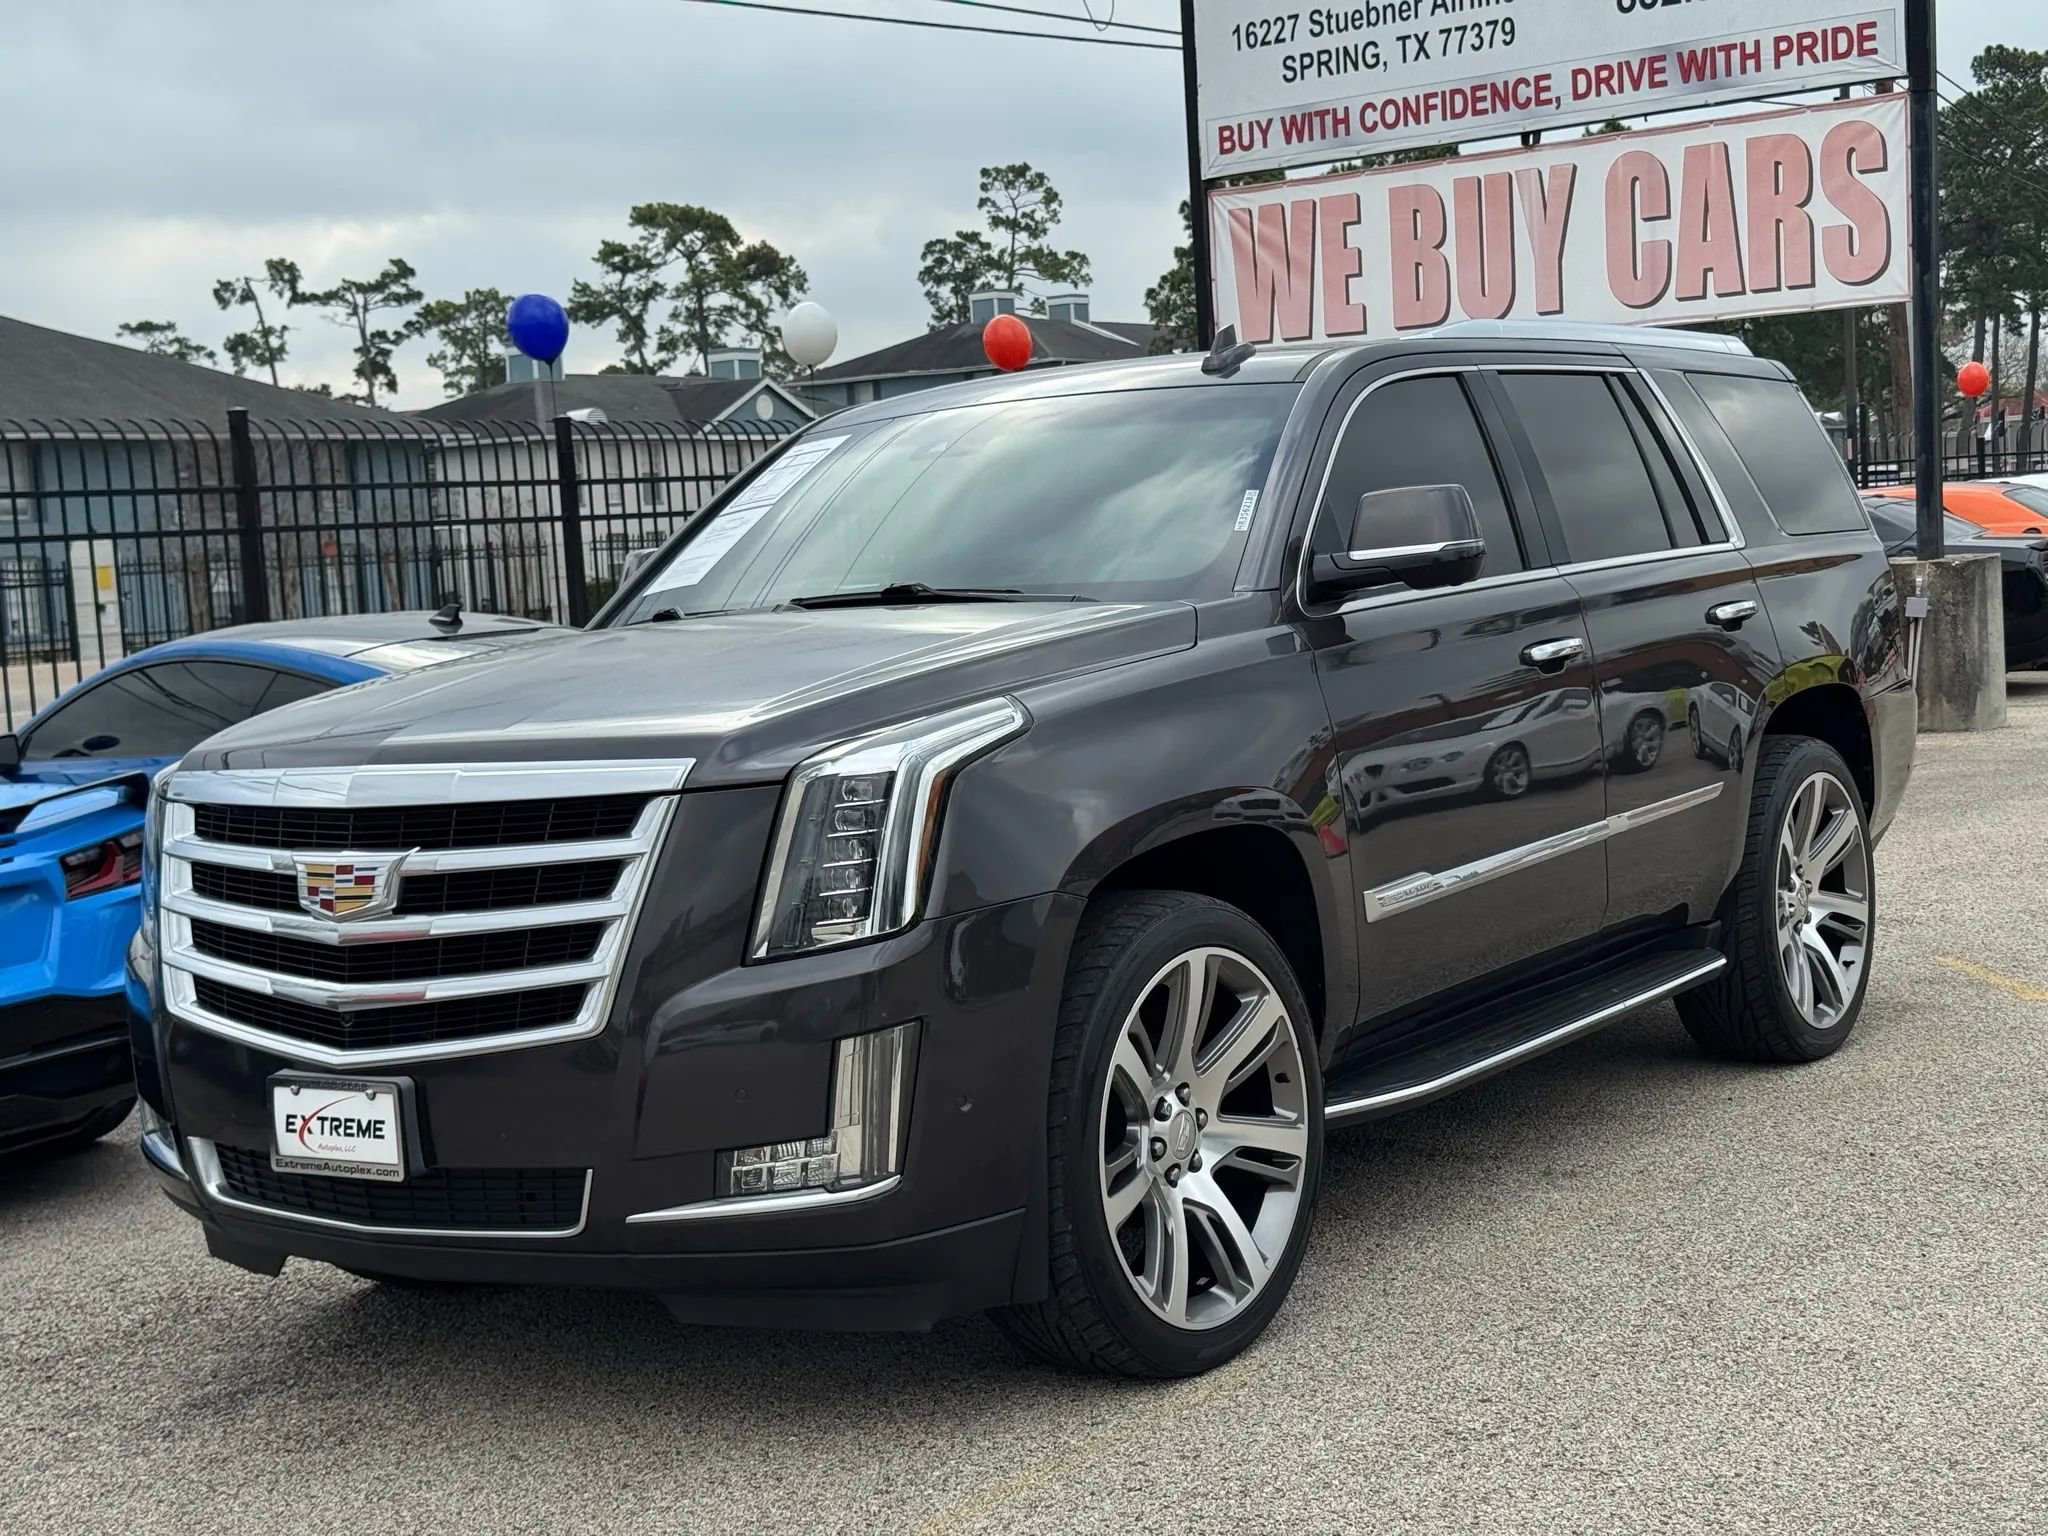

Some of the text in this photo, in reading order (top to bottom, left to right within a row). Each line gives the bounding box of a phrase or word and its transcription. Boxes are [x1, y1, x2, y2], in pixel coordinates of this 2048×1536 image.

[1231, 14, 1300, 52] 16227
[1308, 0, 1422, 38] Stuebner
[1282, 16, 1516, 84] SPRING, TX 77379
[1218, 20, 1879, 155] BUY WITH CONFIDENCE, DRIVE WITH PRIDE
[1227, 120, 1891, 344] WE BUY CARS
[285, 1113, 386, 1140] EXTREME
[275, 1158, 400, 1178] ExtremeAutoplex.com
